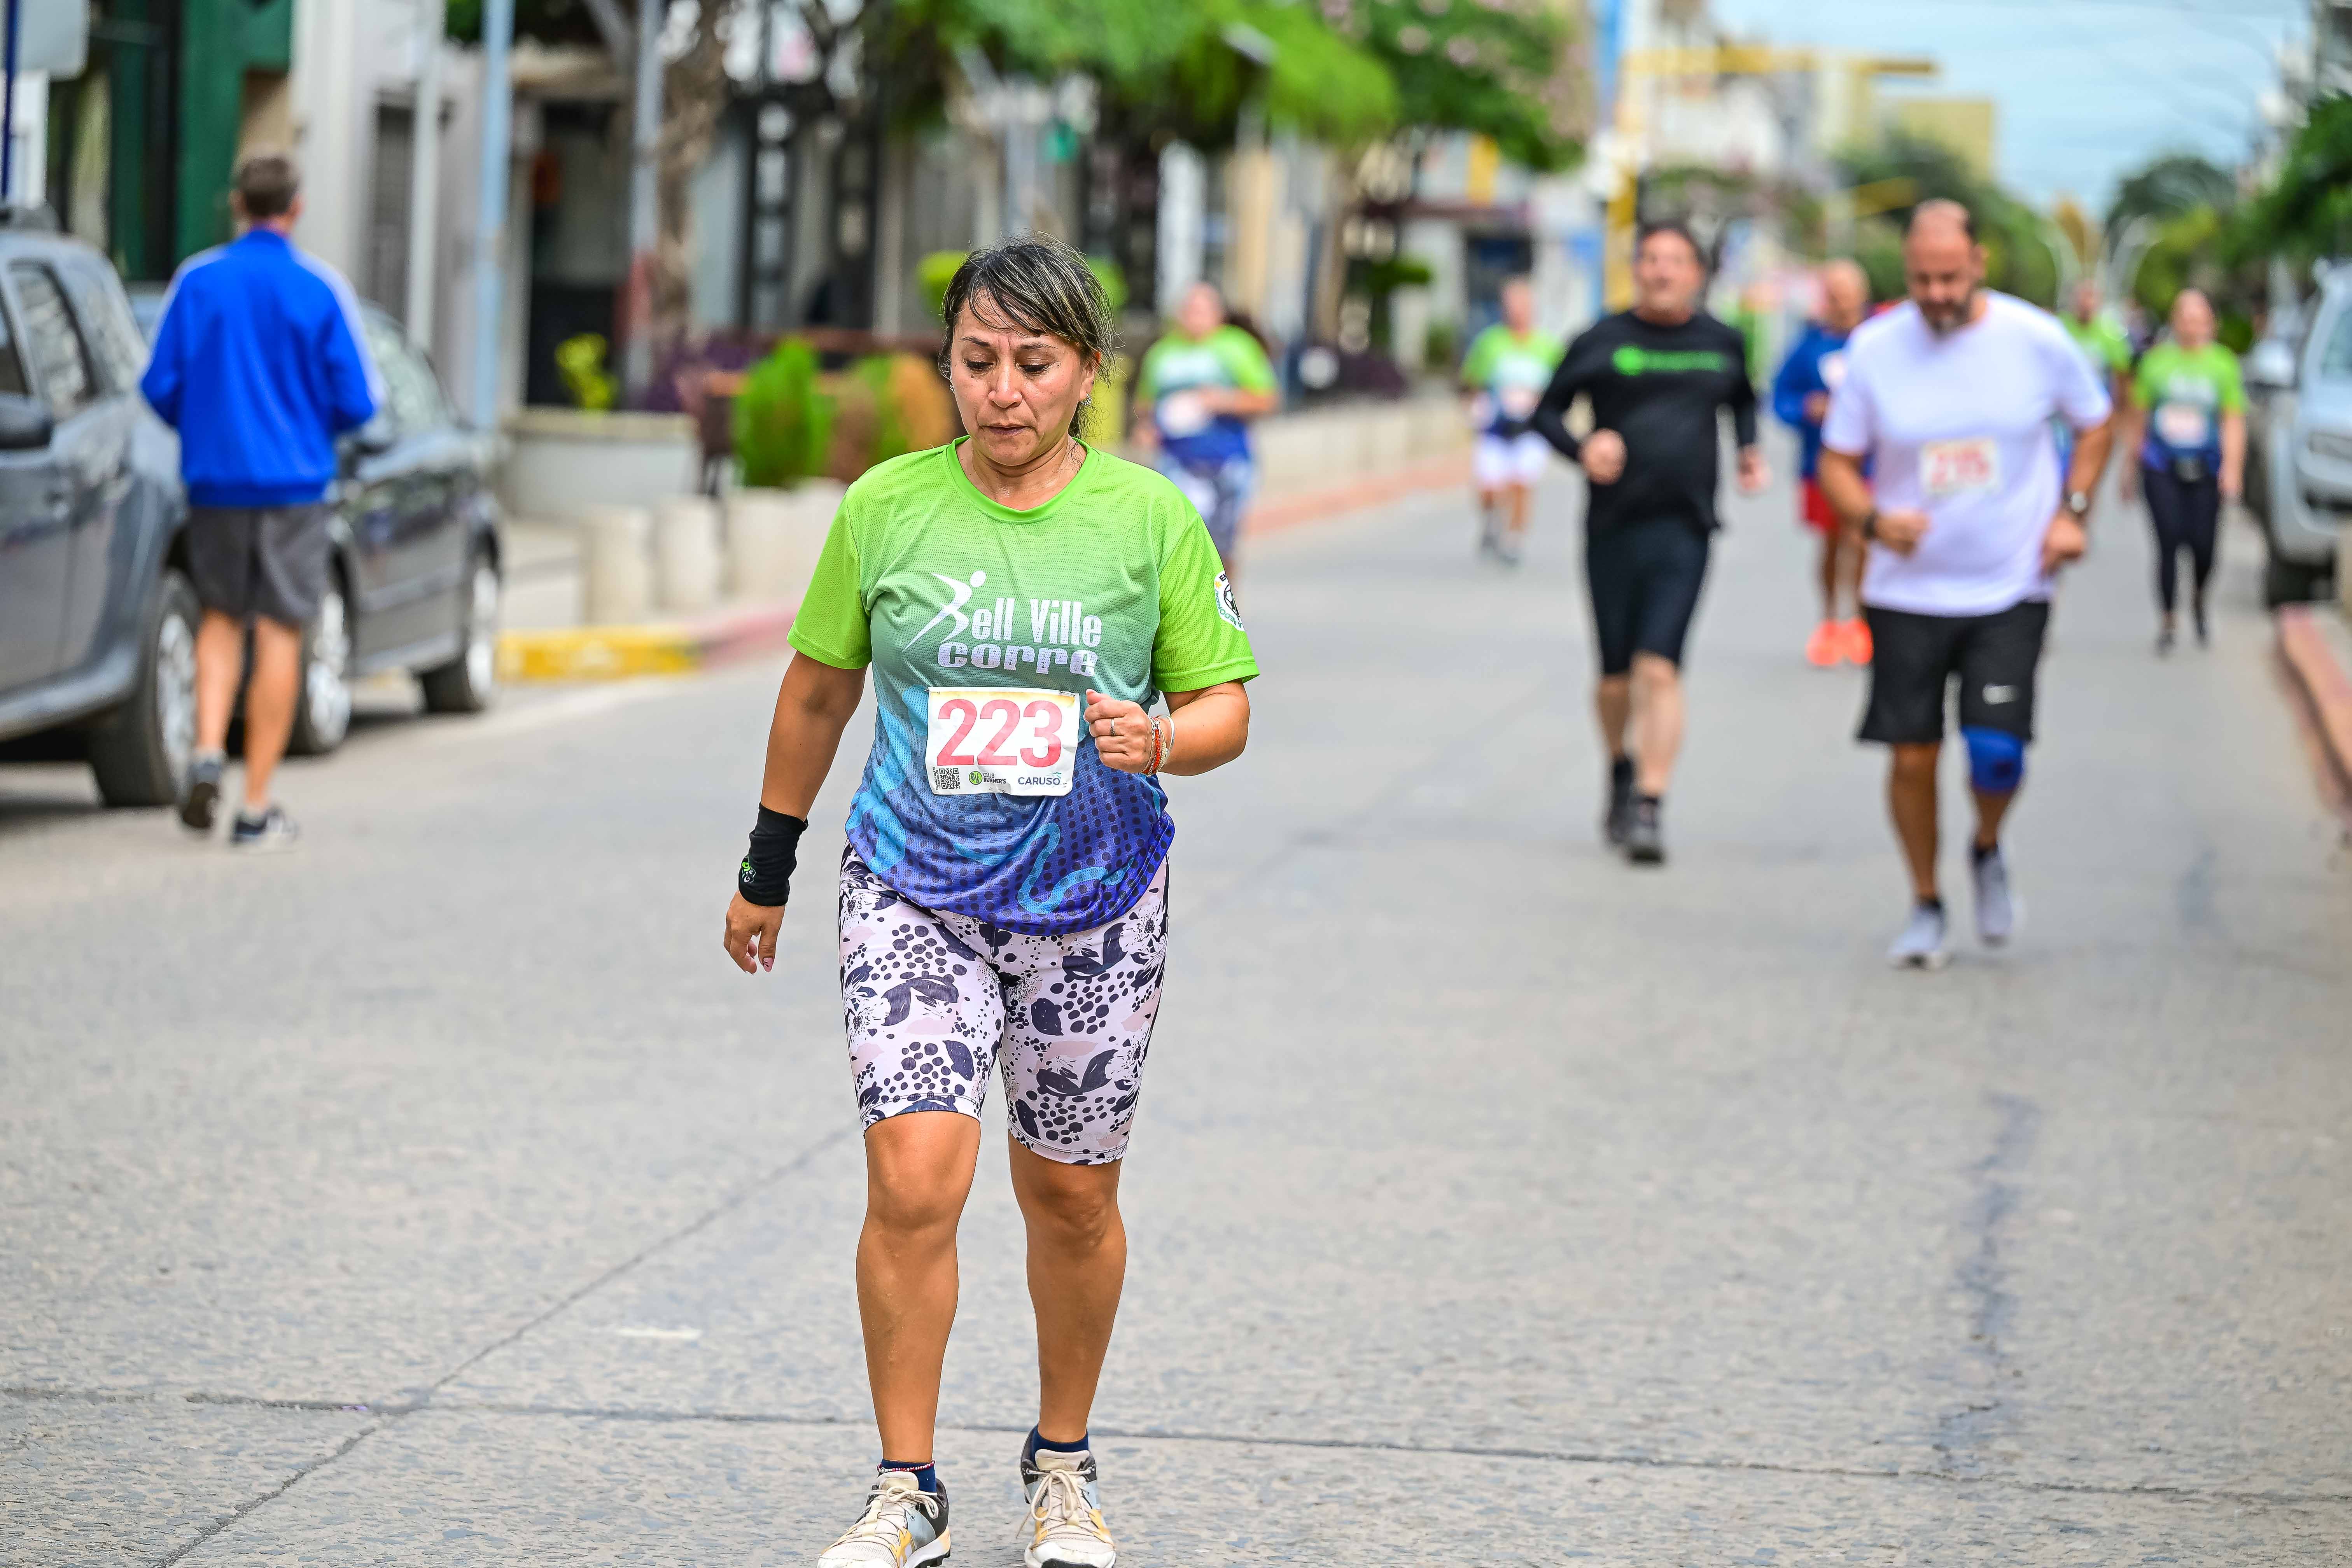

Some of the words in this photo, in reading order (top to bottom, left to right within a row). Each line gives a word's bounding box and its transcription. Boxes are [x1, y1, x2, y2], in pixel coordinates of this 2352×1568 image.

[1029, 598, 1102, 648] Ville
[937, 642, 1099, 677] corre
[936, 698, 1062, 768] 223
[1018, 777, 1060, 786] CARUSO
